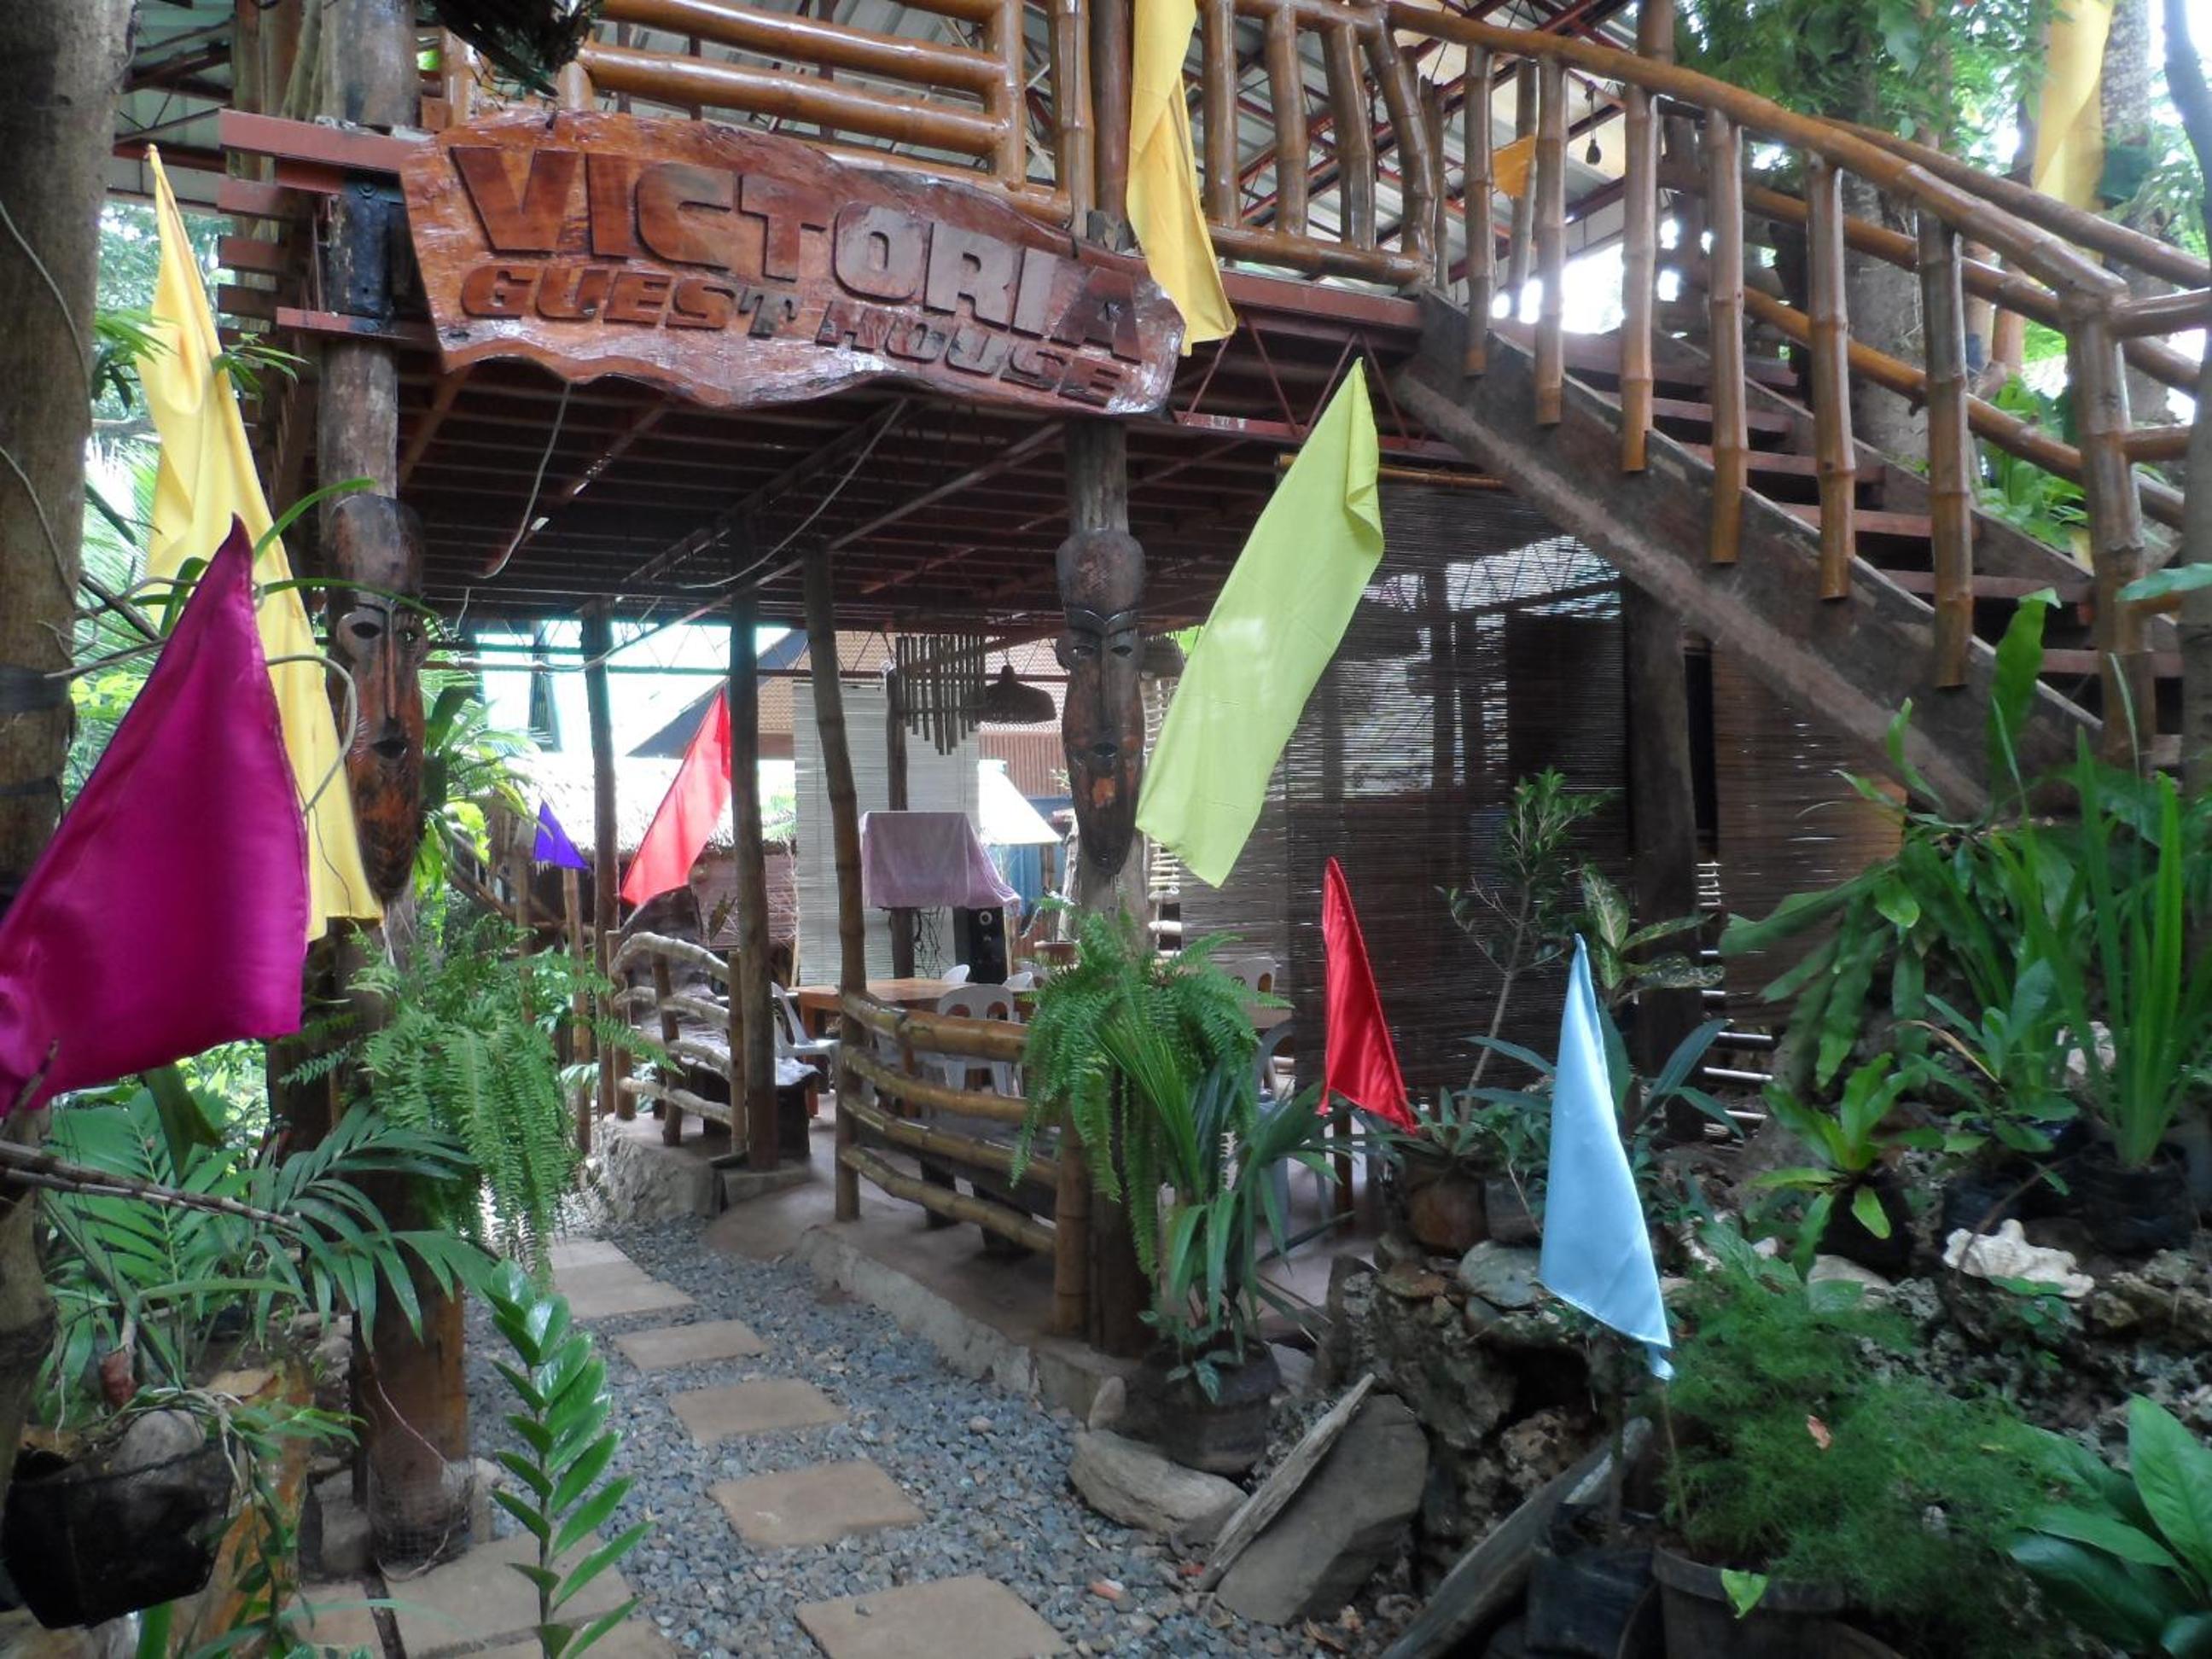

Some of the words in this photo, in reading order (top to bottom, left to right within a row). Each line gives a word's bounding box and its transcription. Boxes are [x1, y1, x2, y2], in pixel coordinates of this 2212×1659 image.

[450, 146, 1142, 364] VICTORIA
[461, 264, 802, 340] GUEST
[815, 300, 1125, 406] HOUSE
